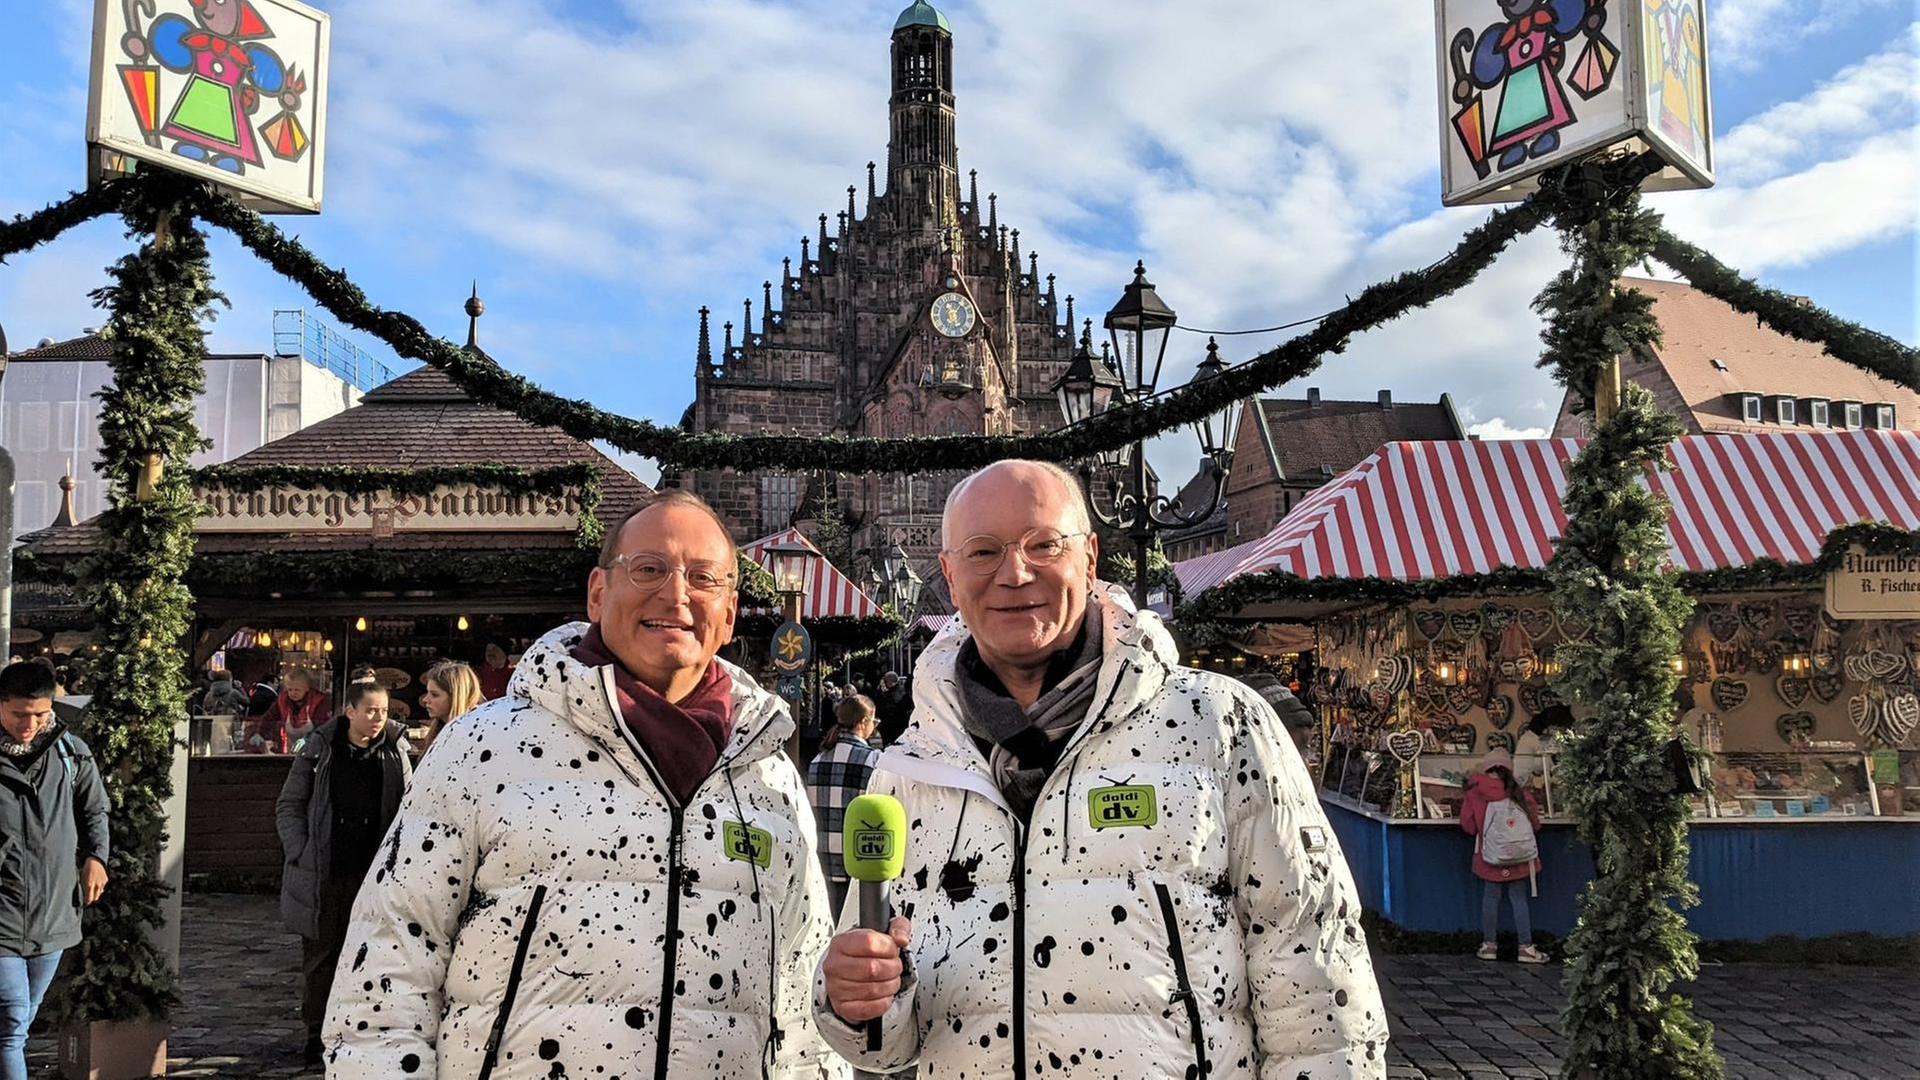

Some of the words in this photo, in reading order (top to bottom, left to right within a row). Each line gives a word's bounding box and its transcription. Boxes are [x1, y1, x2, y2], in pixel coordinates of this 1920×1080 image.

[1861, 578, 1876, 592] R.
[780, 684, 796, 694] WC
[1103, 802, 1140, 820] dv
[861, 841, 885, 853] dv
